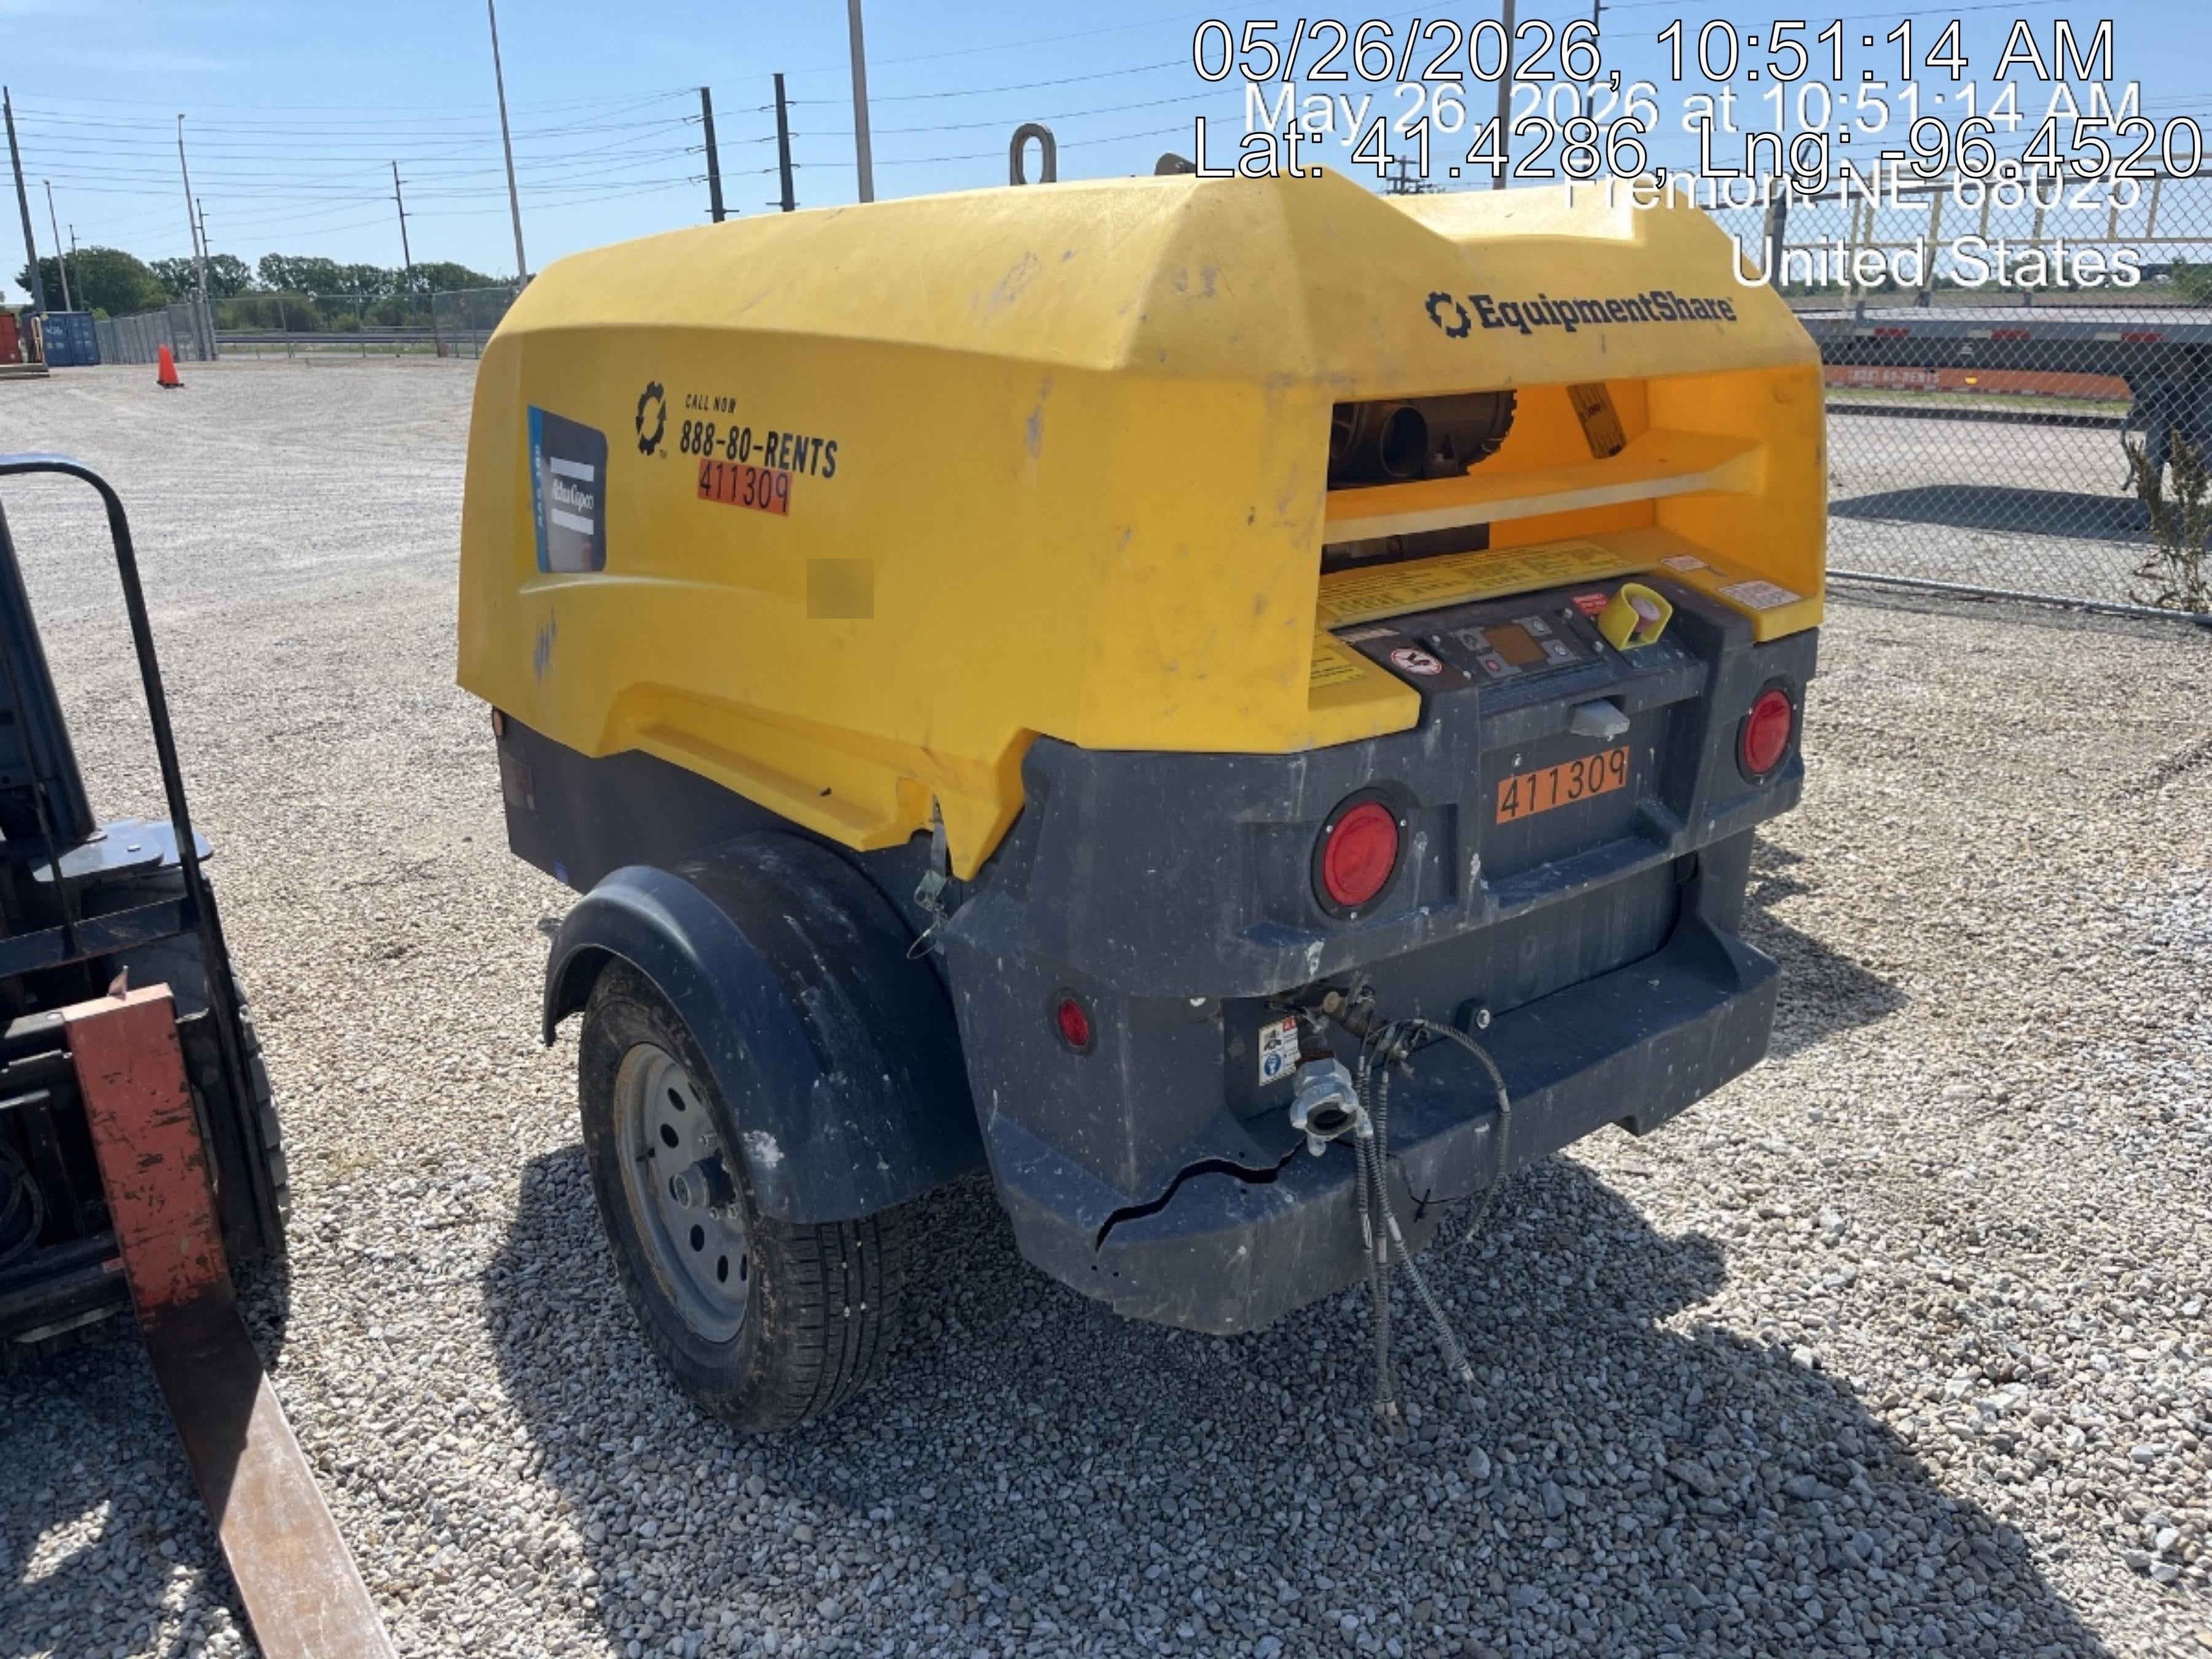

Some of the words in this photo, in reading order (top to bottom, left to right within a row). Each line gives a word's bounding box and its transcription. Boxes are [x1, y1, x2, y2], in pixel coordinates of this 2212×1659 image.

[1469, 291, 1738, 335] EquipmentShare
[685, 394, 708, 411] CALL
[713, 396, 737, 414] NOW
[680, 420, 838, 478] 888-80-RENTS
[699, 460, 788, 513] 411309
[1500, 749, 1625, 817] 411309
